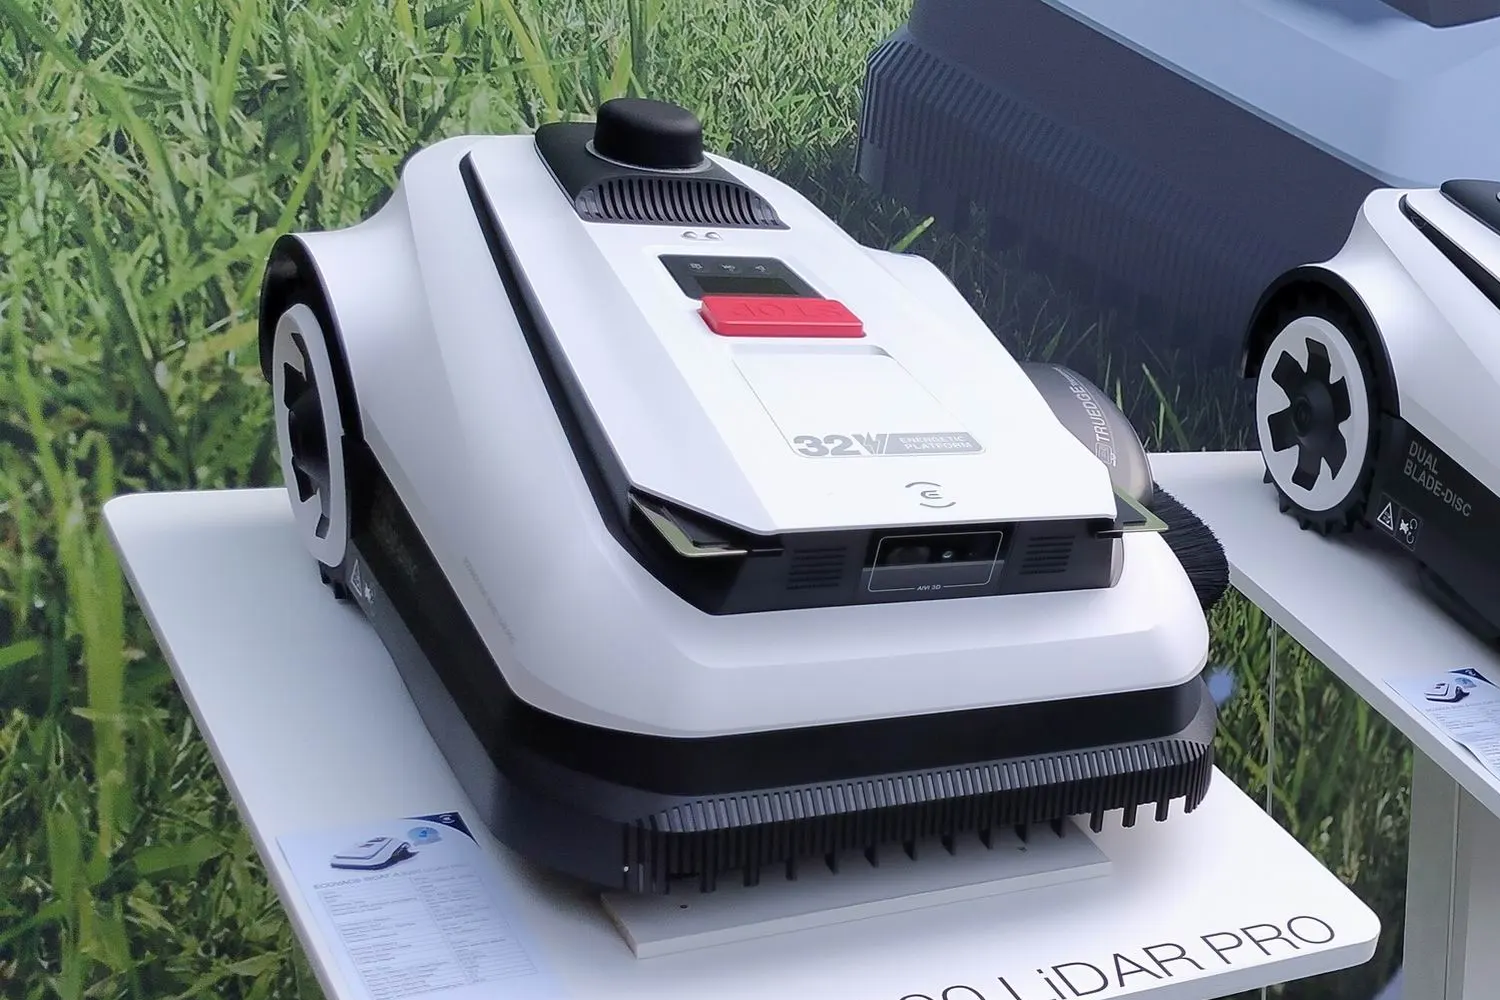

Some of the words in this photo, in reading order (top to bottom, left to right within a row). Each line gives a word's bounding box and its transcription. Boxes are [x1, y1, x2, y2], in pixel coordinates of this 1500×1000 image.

[1069, 385, 1111, 442] TRUEDGE
[899, 435, 967, 443] ENERGETIC
[903, 442, 973, 450] PLATFORM
[1409, 440, 1439, 475] DUAL
[1404, 459, 1472, 517] BLADE-DISC
[1201, 914, 1337, 965] PRO
